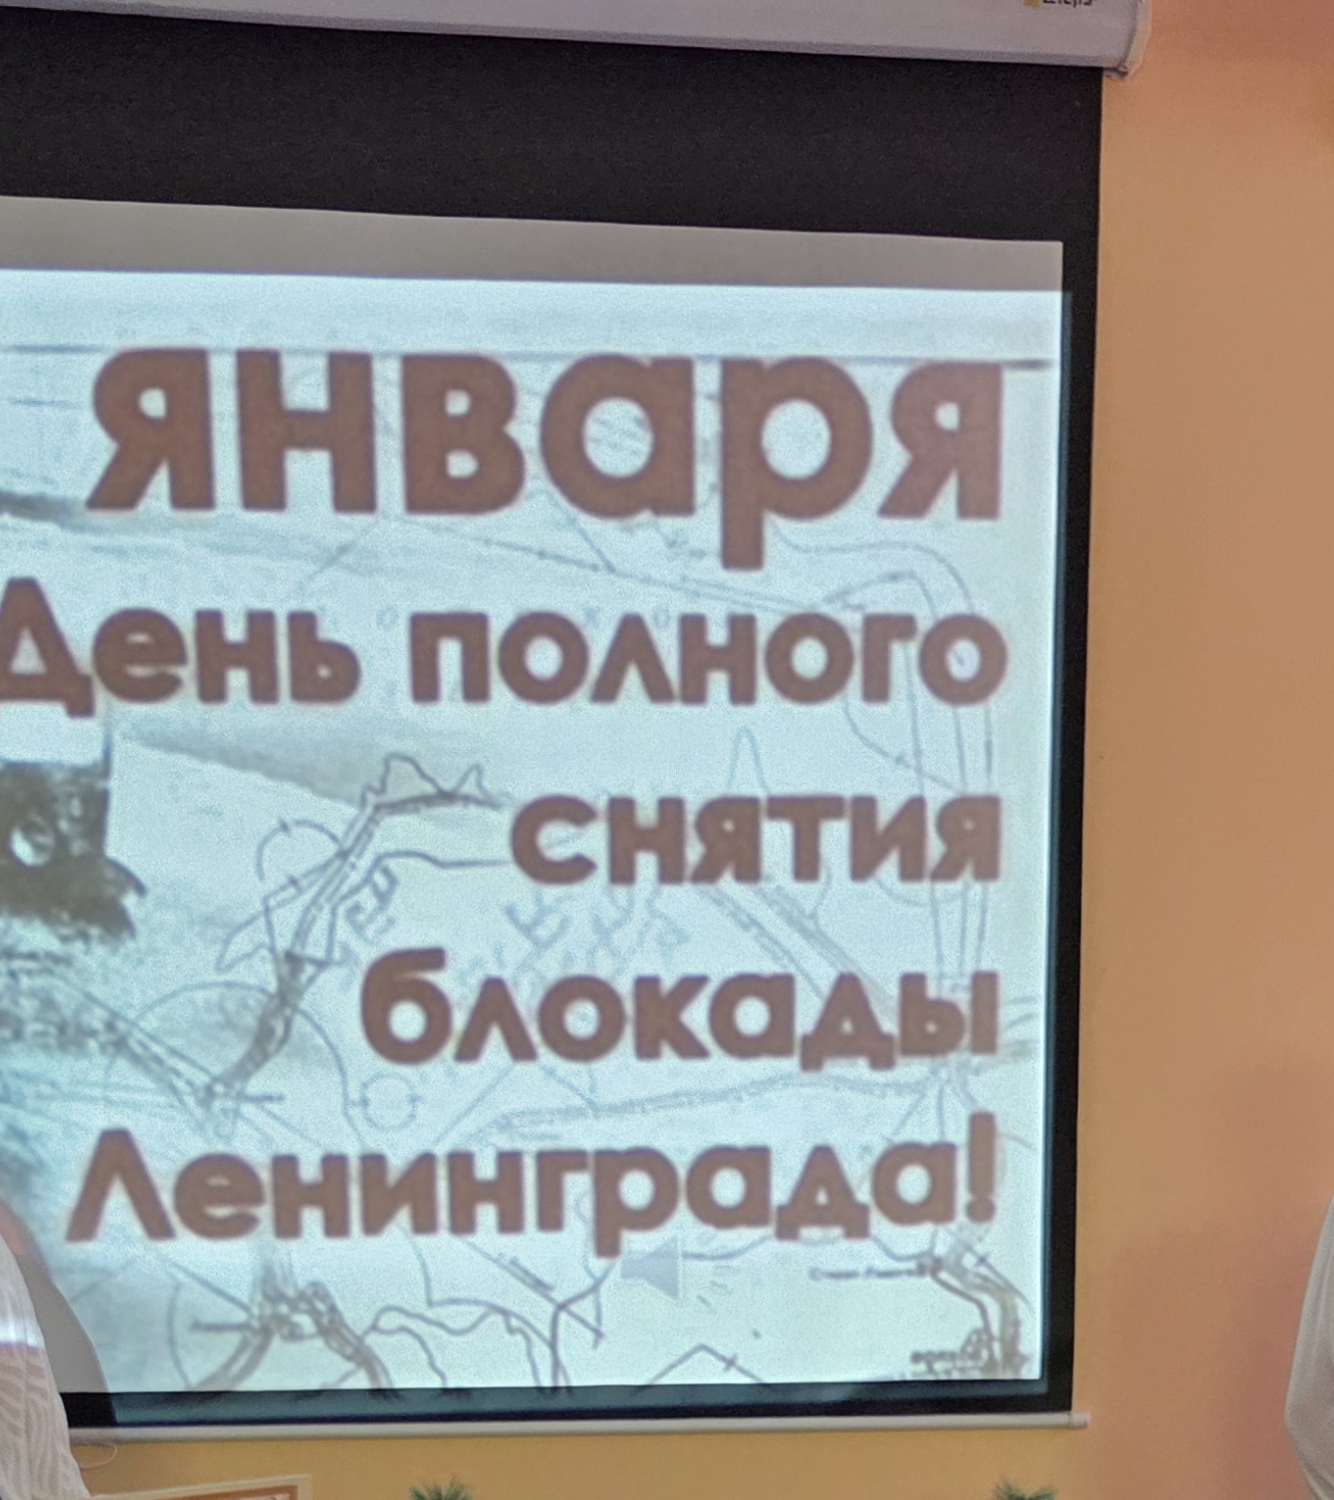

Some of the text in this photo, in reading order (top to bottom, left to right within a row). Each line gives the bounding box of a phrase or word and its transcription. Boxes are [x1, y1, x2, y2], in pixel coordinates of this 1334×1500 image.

[85, 347, 1003, 569] января
[409, 611, 1008, 706] полного
[510, 794, 1003, 885] снятия
[359, 948, 1000, 1072] блокады
[69, 1112, 998, 1257] Ленинграда!
